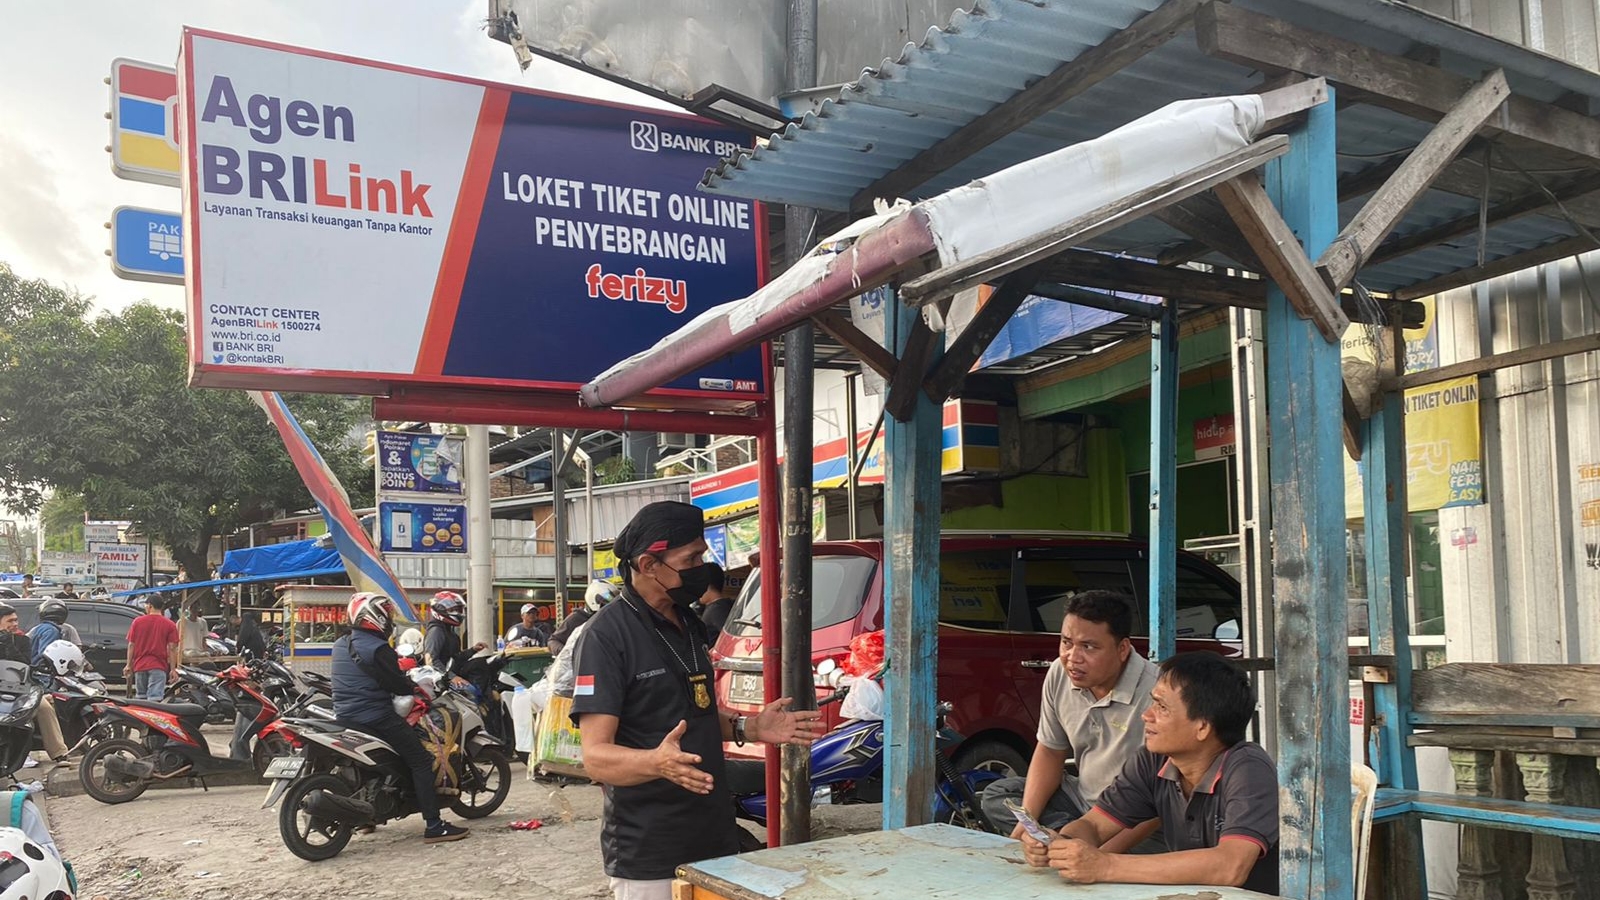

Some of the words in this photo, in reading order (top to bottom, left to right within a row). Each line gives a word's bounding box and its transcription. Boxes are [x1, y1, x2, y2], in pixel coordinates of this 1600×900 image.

[201, 75, 355, 144] Agen
[661, 133, 711, 155] BANK
[202, 144, 434, 218] BRILink
[503, 172, 584, 208] LOKET
[591, 183, 661, 218] TIKET
[668, 194, 750, 229] ONLINE
[203, 201, 253, 219] Layanan
[255, 207, 310, 225] Transaksi
[311, 211, 363, 230] keuangan
[365, 218, 397, 233] Tanpa
[398, 220, 433, 236] Kantor
[535, 216, 726, 265] PENYEBRANGAN
[585, 263, 687, 313] ferizy
[210, 303, 269, 318] CONTACT
[271, 307, 320, 321] CENTER
[211, 317, 279, 330] AgenBRILink
[281, 319, 321, 331] 1500274
[211, 330, 281, 343] www.bri.co.id
[226, 342, 254, 352] BANK
[256, 342, 274, 353] BRI
[226, 353, 284, 365] @kontakBRI
[736, 381, 756, 391] AMT
[1412, 391, 1441, 411] TIKET
[1197, 425, 1225, 440] hidup
[387, 451, 401, 465] &
[381, 472, 415, 481] BONUS
[97, 552, 139, 561] FAMILY
